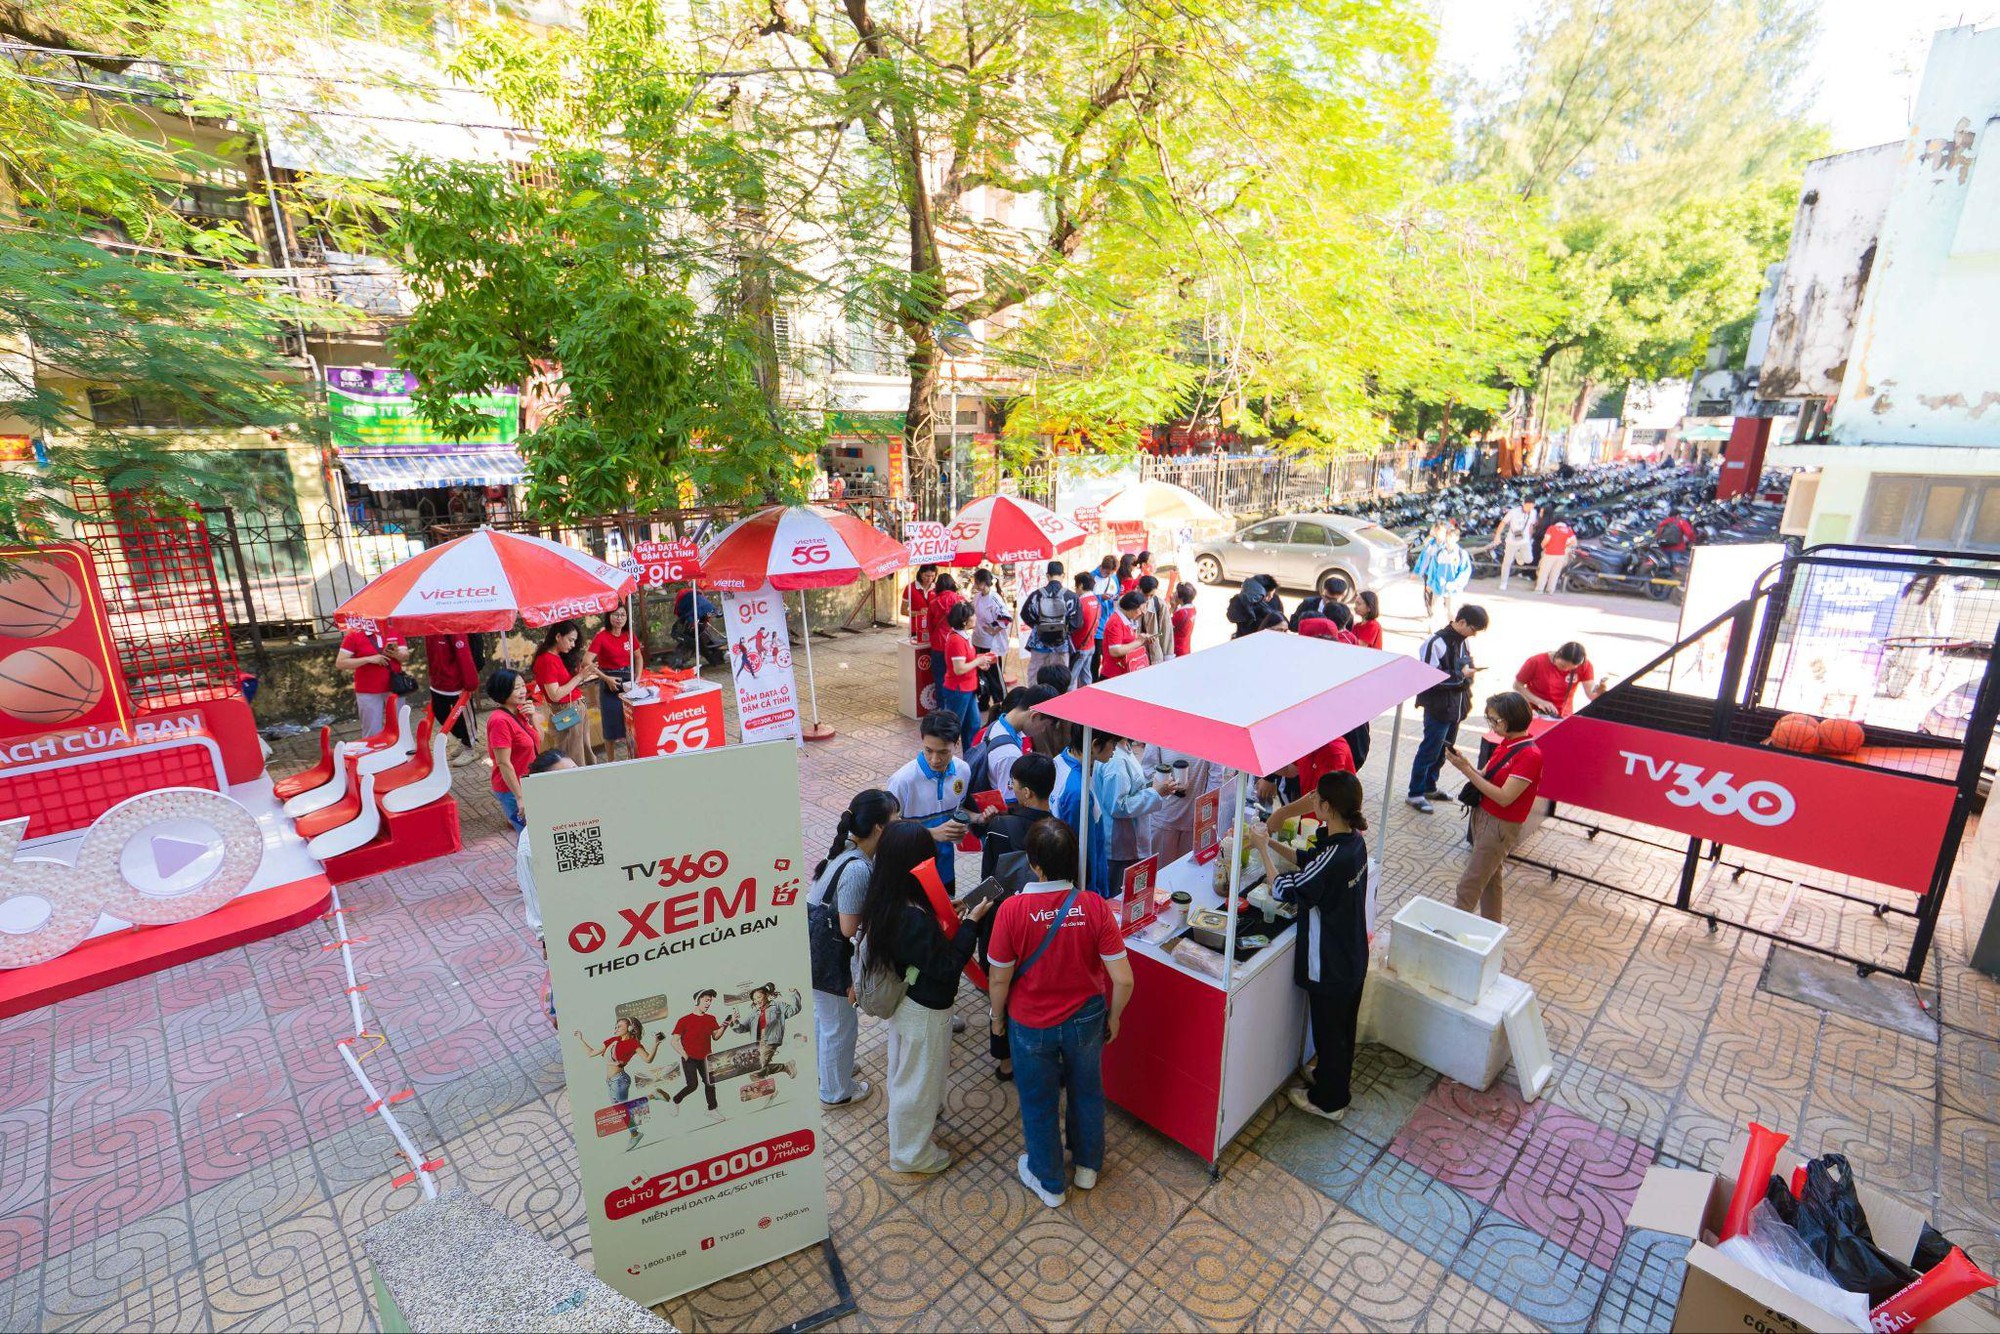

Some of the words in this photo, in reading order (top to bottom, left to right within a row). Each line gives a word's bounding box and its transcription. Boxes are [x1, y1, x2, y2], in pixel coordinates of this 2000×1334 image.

[906, 524, 942, 539] TV360
[950, 521, 983, 541] 5G
[791, 544, 830, 566] 5G
[911, 539, 949, 557] XEM
[996, 549, 1044, 562] viettel
[713, 578, 746, 589] viettel
[540, 597, 603, 622] viettel
[663, 705, 707, 722] viettel
[62, 727, 132, 750] CỦA
[656, 716, 709, 756] 5G
[1619, 750, 1796, 826] TV360
[621, 850, 729, 887] TV360
[617, 877, 757, 948] XEM
[584, 952, 640, 978] THEO
[644, 938, 695, 962] CÁCH
[699, 926, 736, 945] CỦA
[740, 915, 778, 935] BẠN
[772, 1140, 793, 1151] VNĐ
[773, 1143, 810, 1161] /THÁNG
[658, 1146, 769, 1200] 20.000
[717, 1184, 747, 1199] 4G/5G
[749, 1170, 788, 1188] VIETTEL
[775, 1206, 811, 1222] tv360.vn
[719, 1228, 745, 1242] TV360
